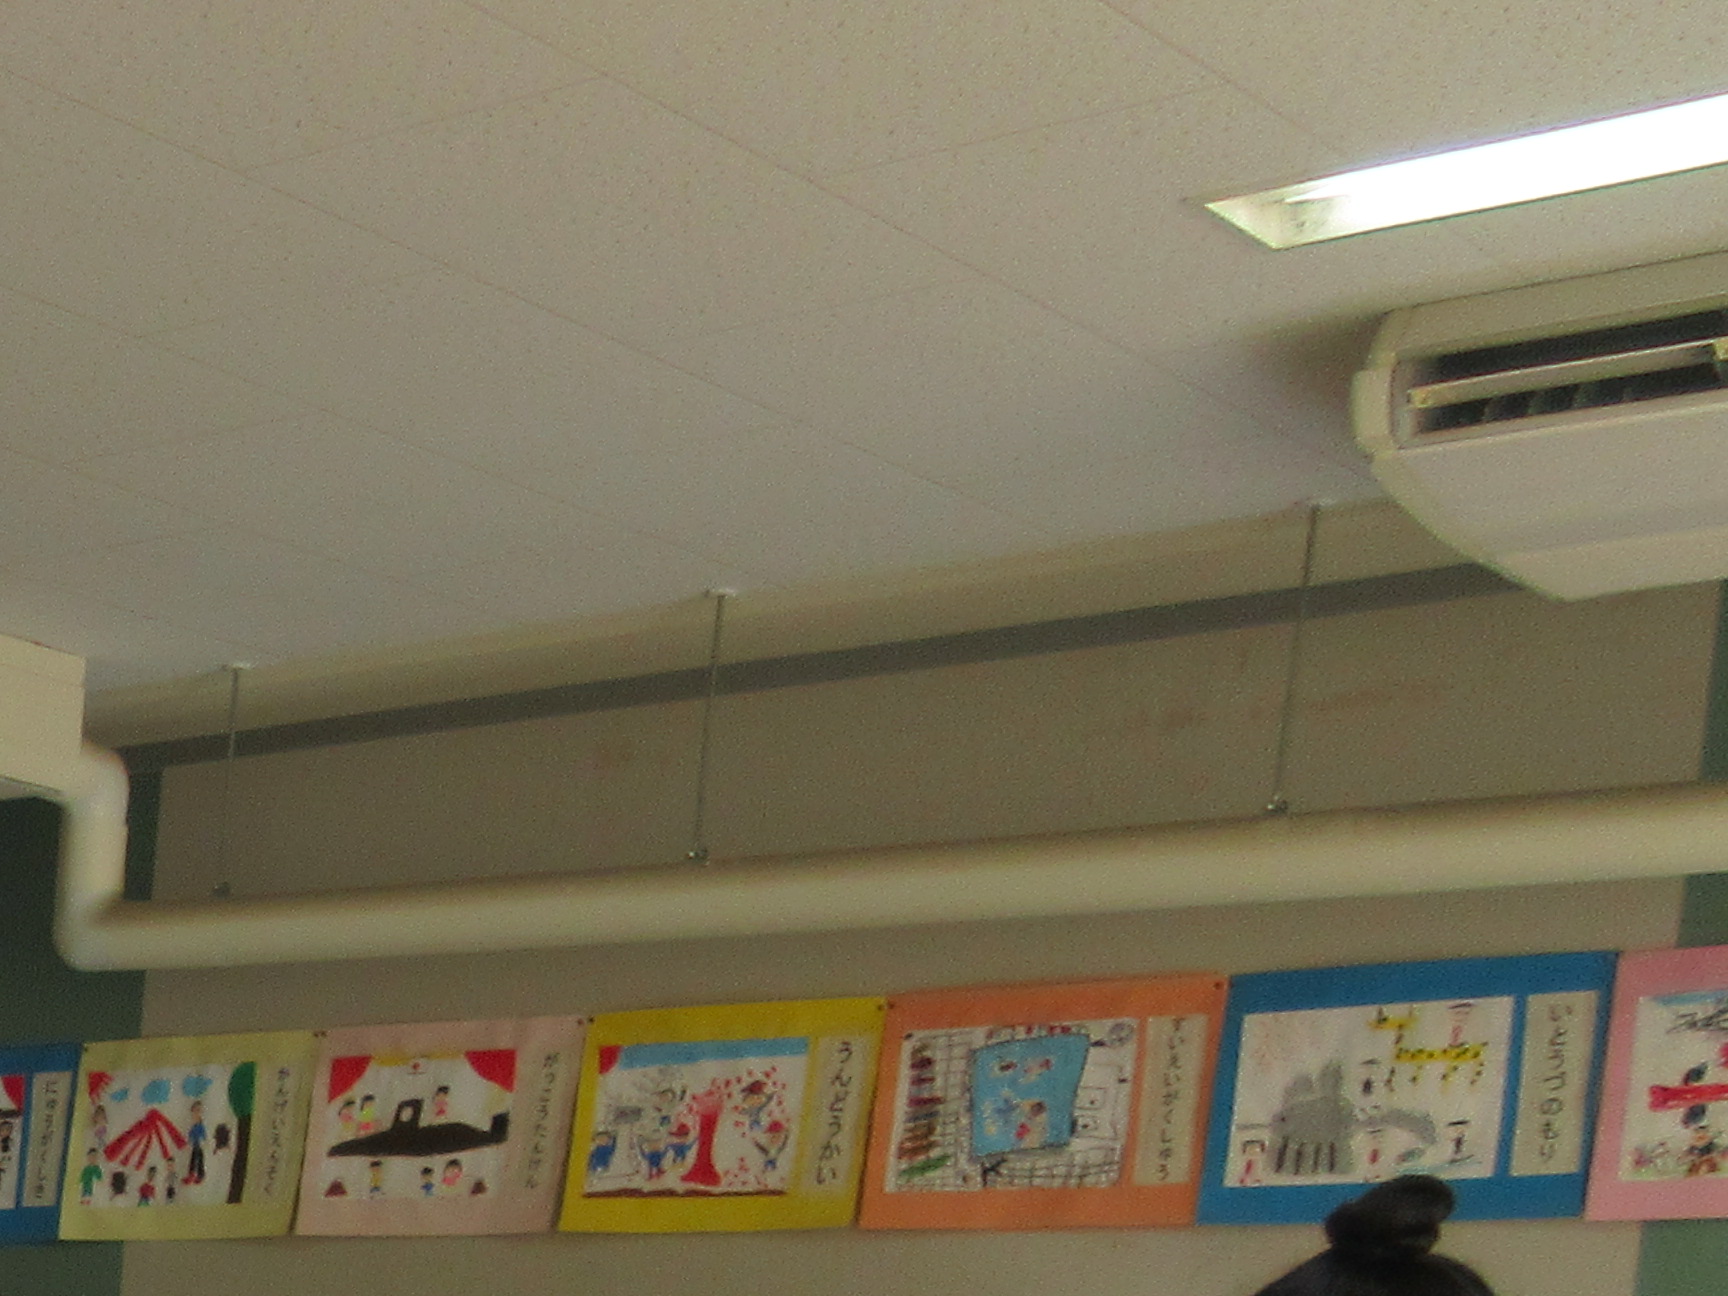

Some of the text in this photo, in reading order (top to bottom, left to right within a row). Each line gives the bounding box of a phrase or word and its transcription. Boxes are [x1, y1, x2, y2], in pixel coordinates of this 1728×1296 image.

[815, 1040, 854, 1186] うんどうかい
